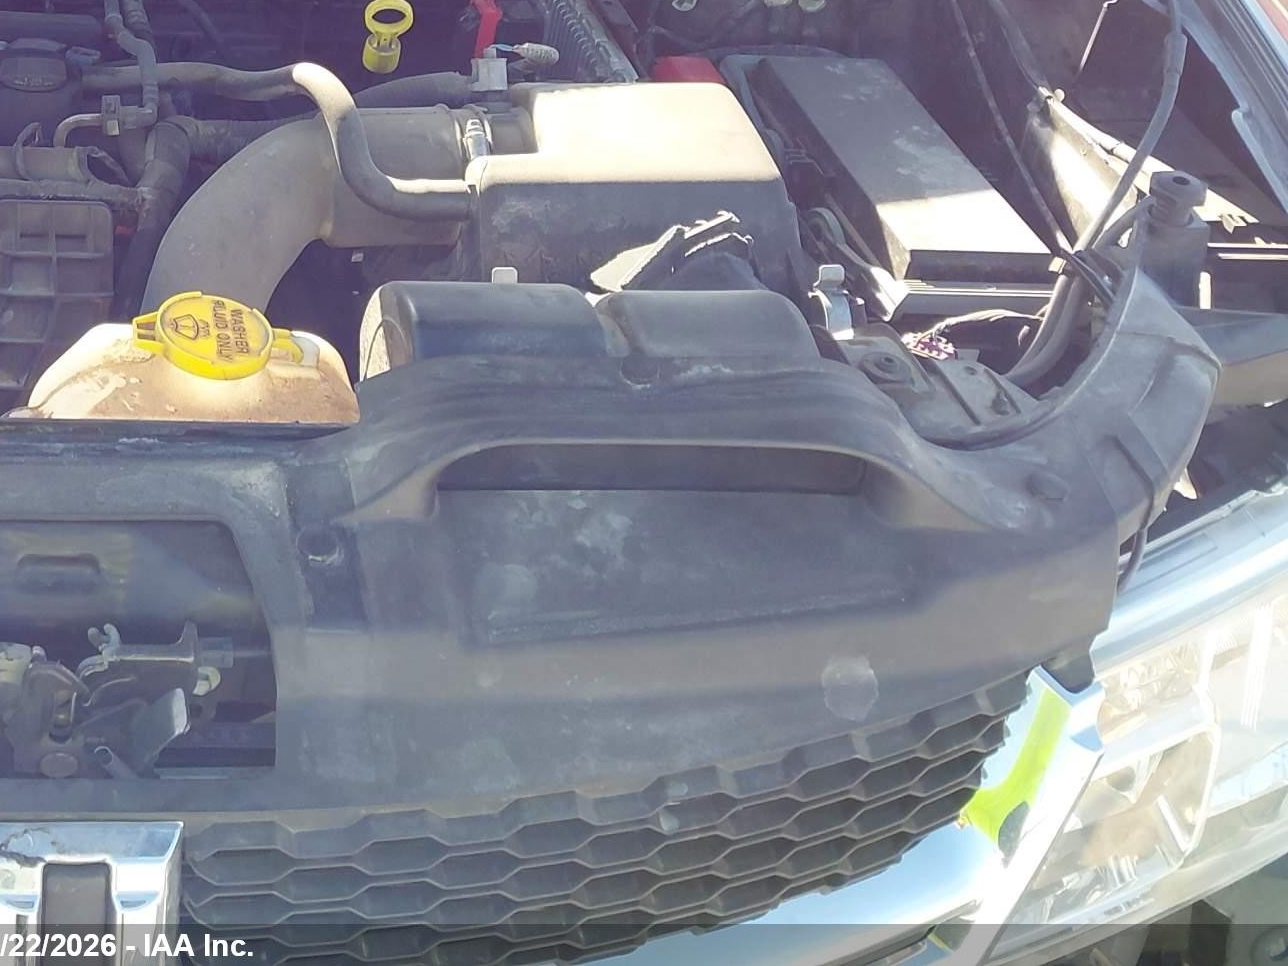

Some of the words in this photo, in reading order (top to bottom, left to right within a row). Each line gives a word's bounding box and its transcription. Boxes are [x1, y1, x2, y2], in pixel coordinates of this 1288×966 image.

[212, 299, 229, 329] FLUID
[230, 309, 249, 354] WASHER
[216, 332, 233, 362] ONLY
